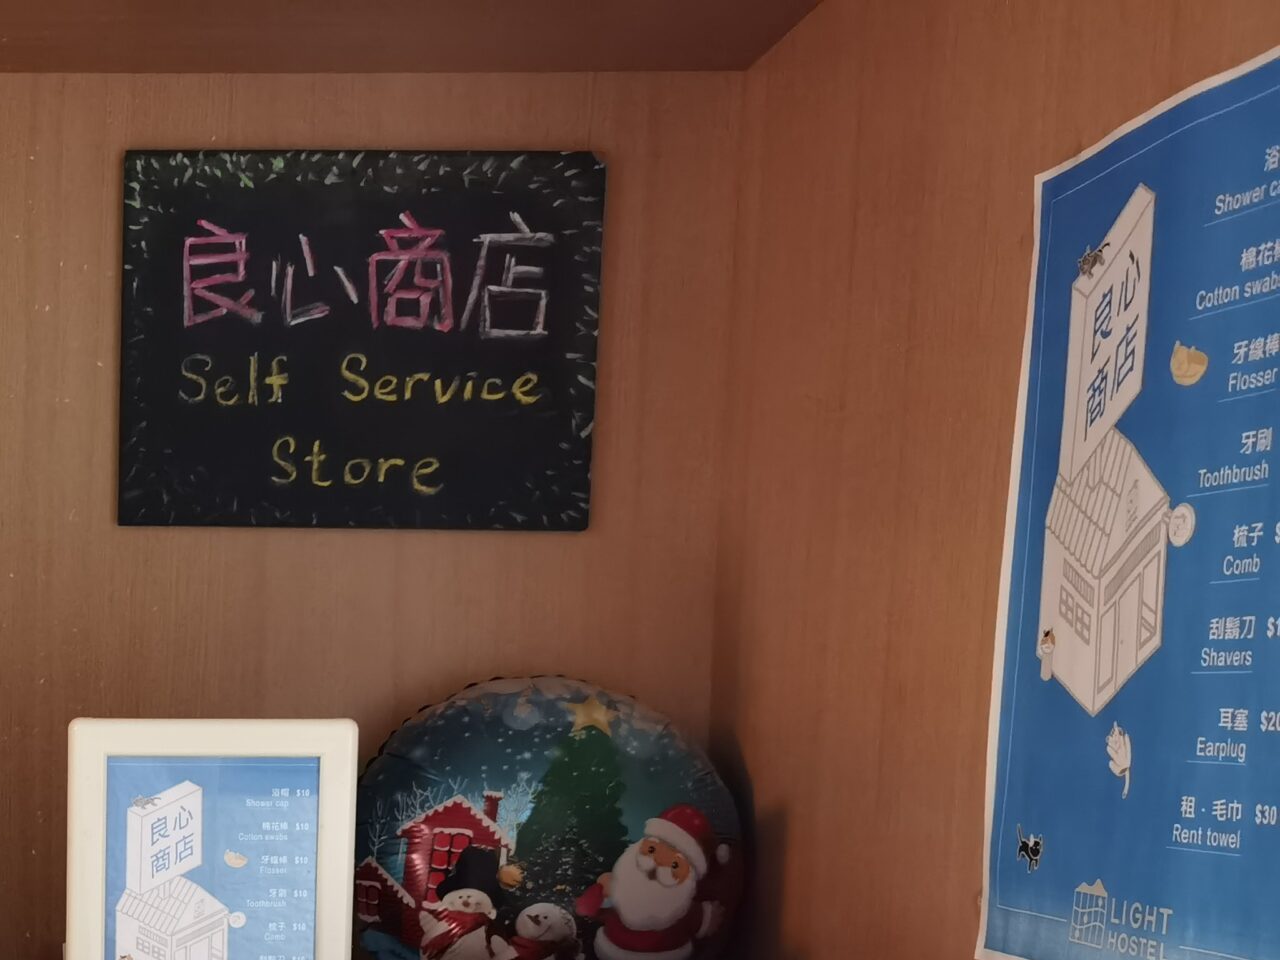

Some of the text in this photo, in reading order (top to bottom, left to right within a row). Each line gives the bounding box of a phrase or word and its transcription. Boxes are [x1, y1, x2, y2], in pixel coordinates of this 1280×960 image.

[1214, 183, 1267, 215] Shower
[183, 210, 555, 340] 良心商店
[1196, 285, 1240, 310] Cotton
[179, 351, 543, 407] Self Service
[1228, 367, 1278, 392] Flosser
[1240, 427, 1273, 455] 牙刷
[271, 436, 444, 495] Store
[1198, 459, 1269, 488] Toothbrush
[1233, 522, 1264, 548] 梳子
[1223, 553, 1261, 575] Comb
[1200, 647, 1253, 667] Shavers
[1218, 708, 1248, 731] 耳塞
[1196, 736, 1247, 763] Earplug
[150, 804, 195, 847] 良心
[1255, 804, 1277, 825] $30
[1172, 823, 1241, 849] Rent towel
[150, 835, 195, 880] 商店
[1110, 907, 1174, 936] LIGHT
